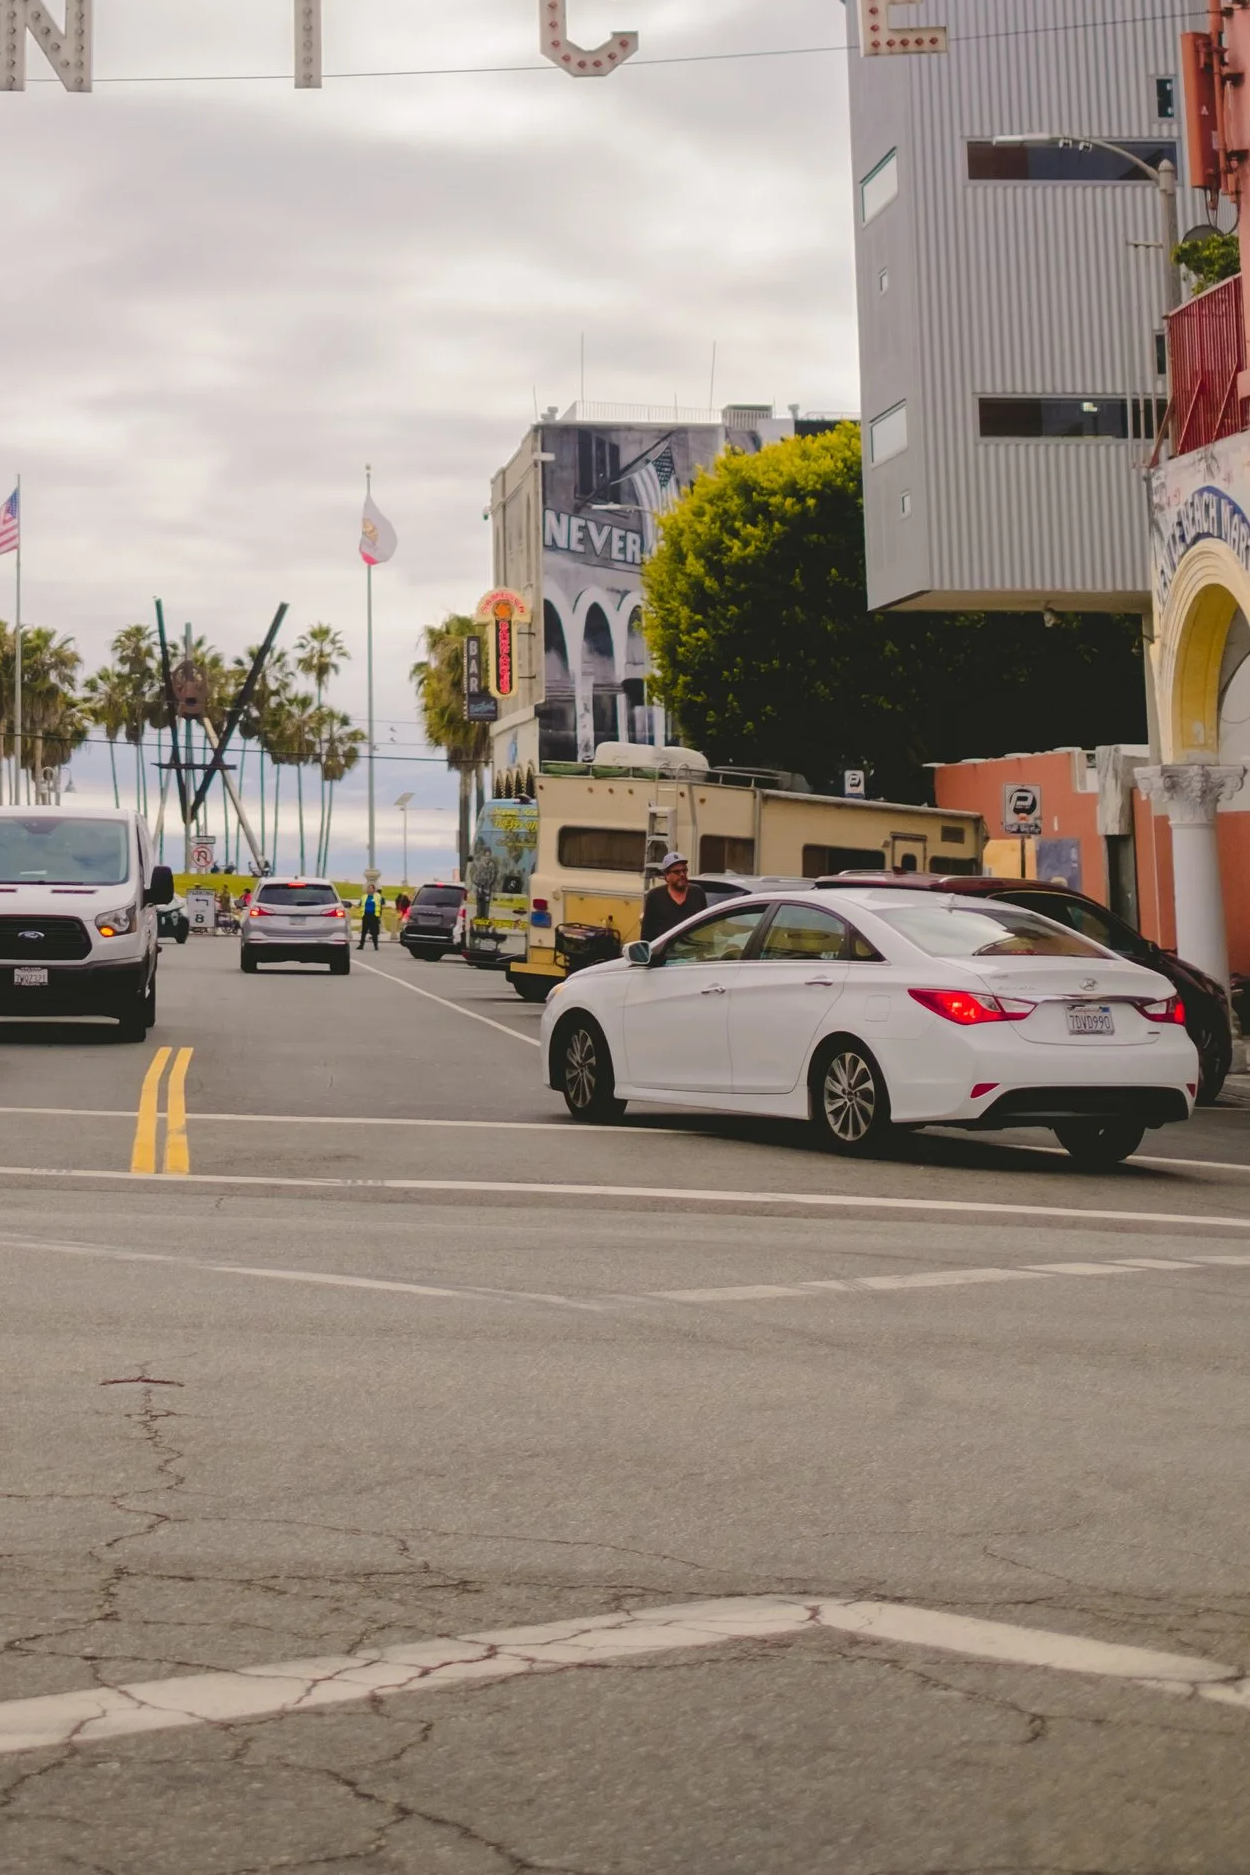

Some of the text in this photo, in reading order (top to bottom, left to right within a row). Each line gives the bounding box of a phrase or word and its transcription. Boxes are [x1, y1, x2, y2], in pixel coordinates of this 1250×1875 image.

[543, 508, 642, 565] NEVER
[1181, 491, 1219, 544] BEACH
[1221, 499, 1250, 575] MAR
[468, 640, 479, 693] BAR
[195, 913, 204, 923] 8
[1068, 1015, 1111, 1030] 7DVD990
